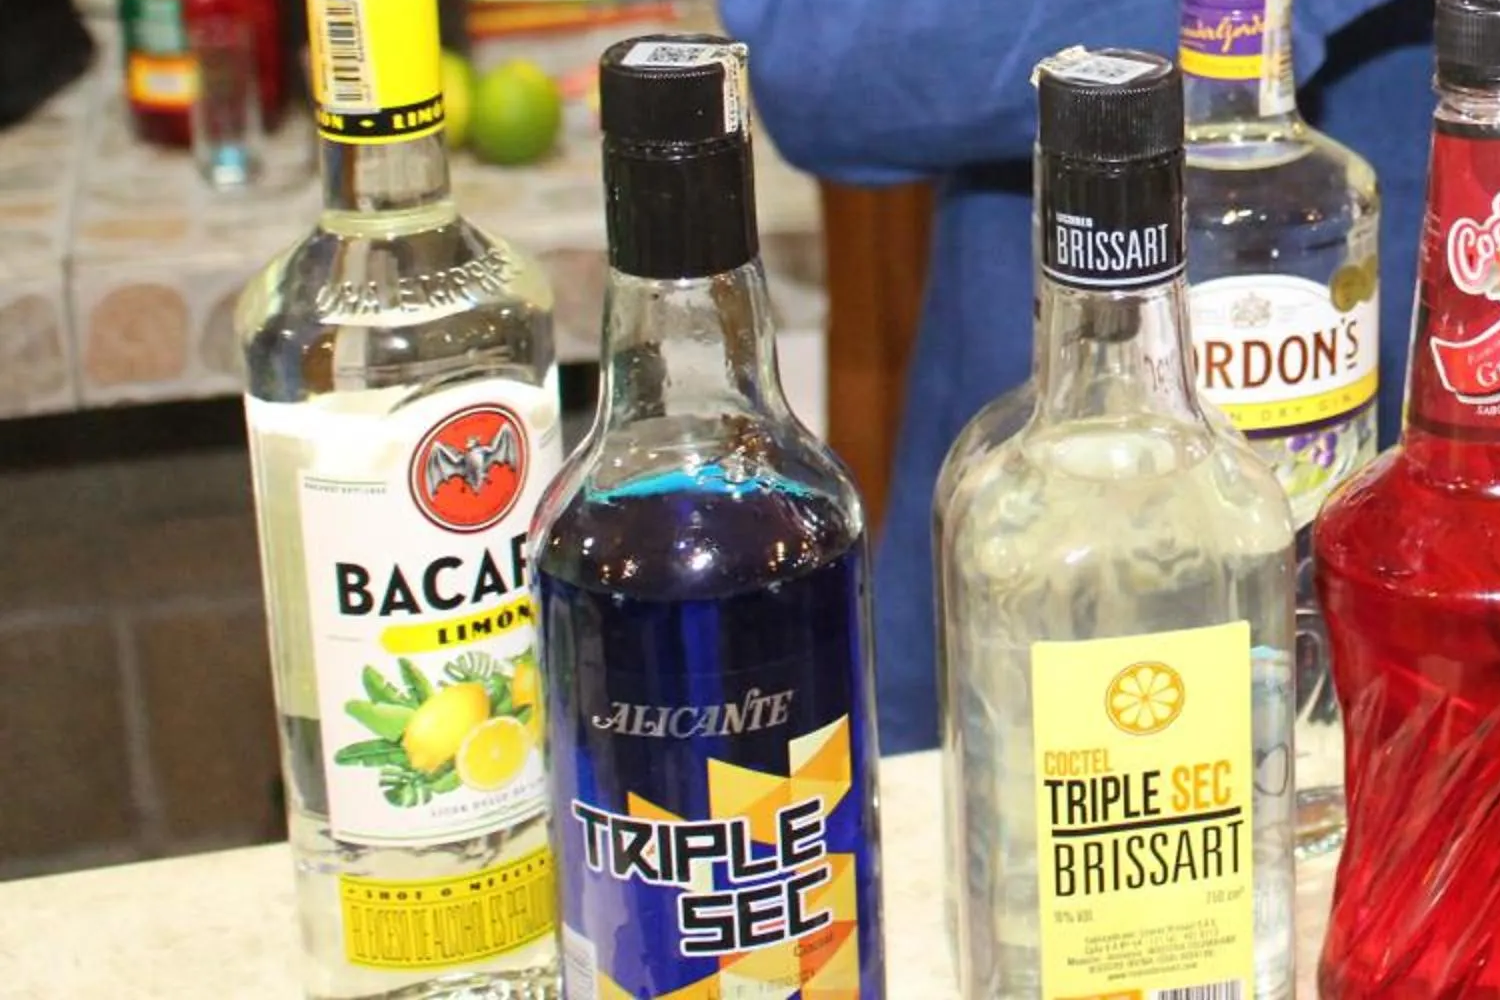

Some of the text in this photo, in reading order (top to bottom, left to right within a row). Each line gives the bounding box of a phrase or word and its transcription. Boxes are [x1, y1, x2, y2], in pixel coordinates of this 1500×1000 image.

[1056, 223, 1168, 271] BRISSART
[1193, 317, 1358, 389] RDON'S
[592, 687, 795, 738] ALICANTE
[1044, 748, 1113, 777] COCTEL
[1044, 759, 1232, 826] TRIPLE SEC
[571, 797, 827, 885] TRIPLE
[1054, 819, 1244, 898] BRISSART
[678, 863, 833, 956] SEC
